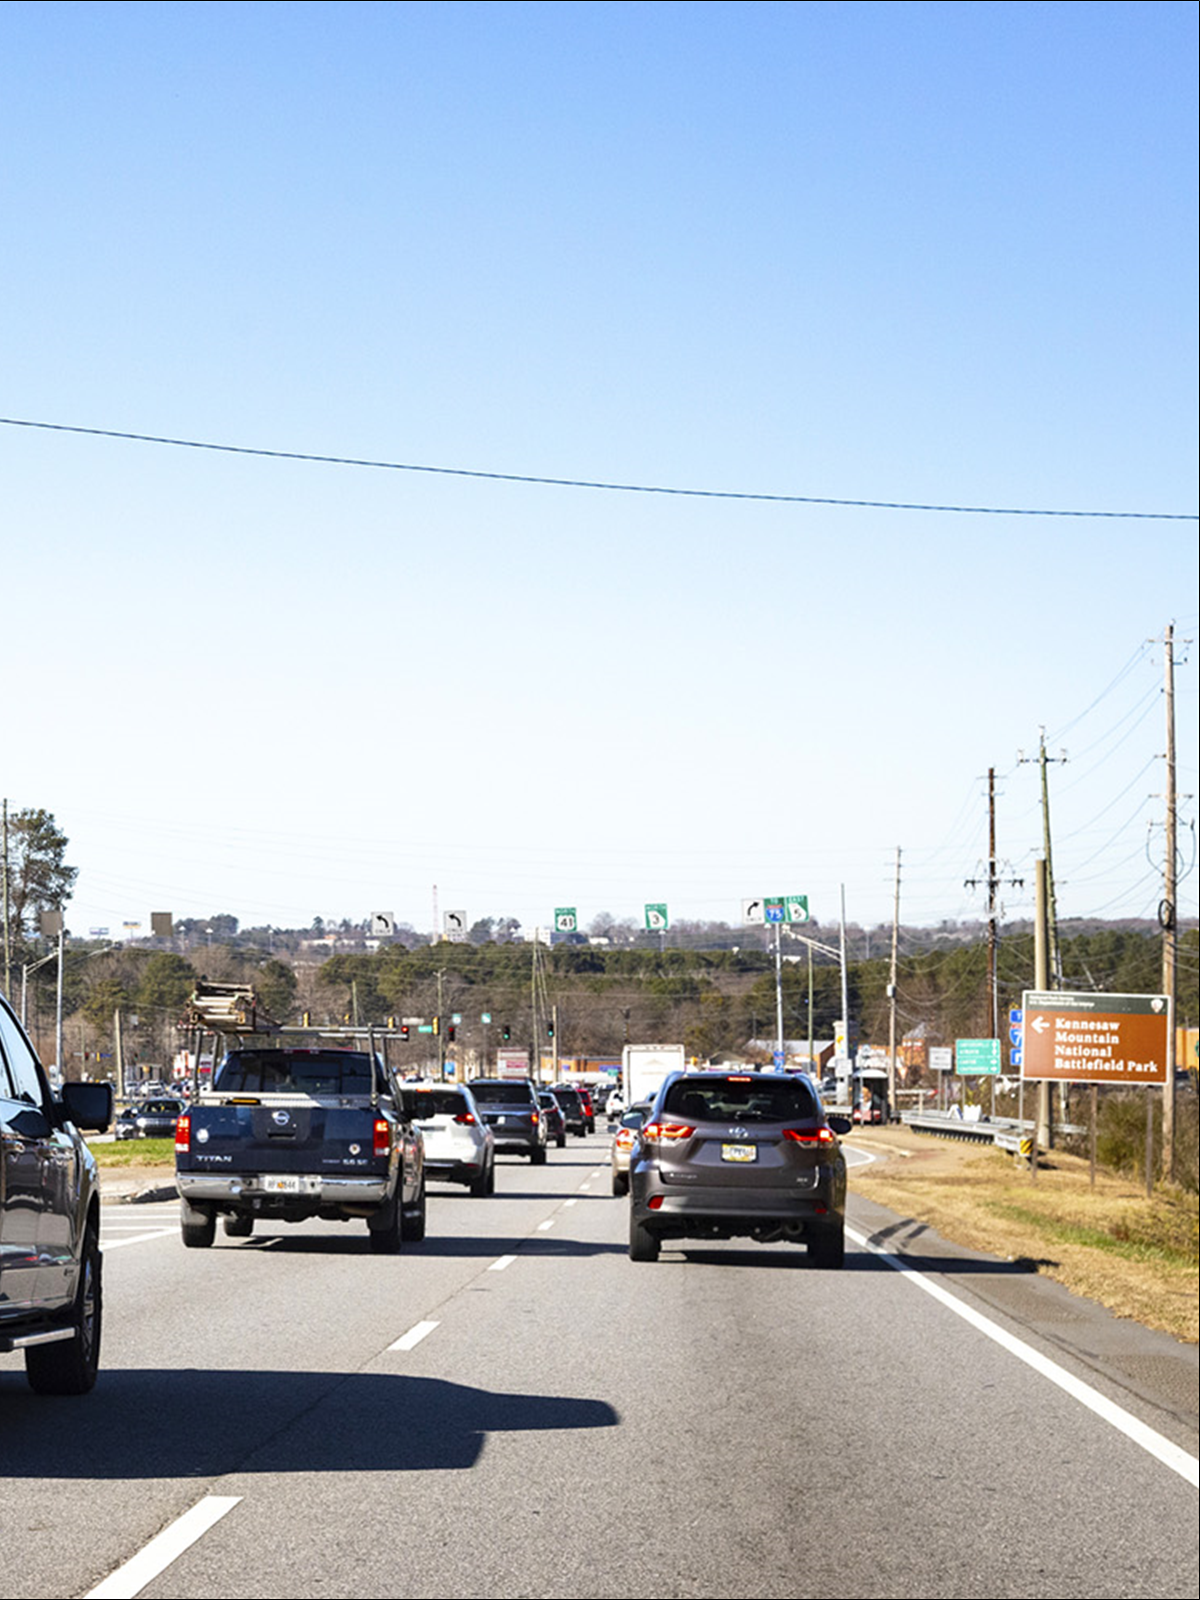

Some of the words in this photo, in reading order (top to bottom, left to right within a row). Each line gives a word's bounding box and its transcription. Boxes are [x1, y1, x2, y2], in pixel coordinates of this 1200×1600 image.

[652, 914, 660, 925] 3
[769, 909, 782, 919] 75
[560, 917, 573, 927] 41
[1055, 1018, 1121, 1030] Kennesaw
[1055, 1032, 1120, 1044] Mountain
[1054, 1045, 1112, 1057] National
[1054, 1058, 1124, 1071] Battlefield
[1127, 1060, 1158, 1073] Park
[196, 1154, 232, 1163] TITAN
